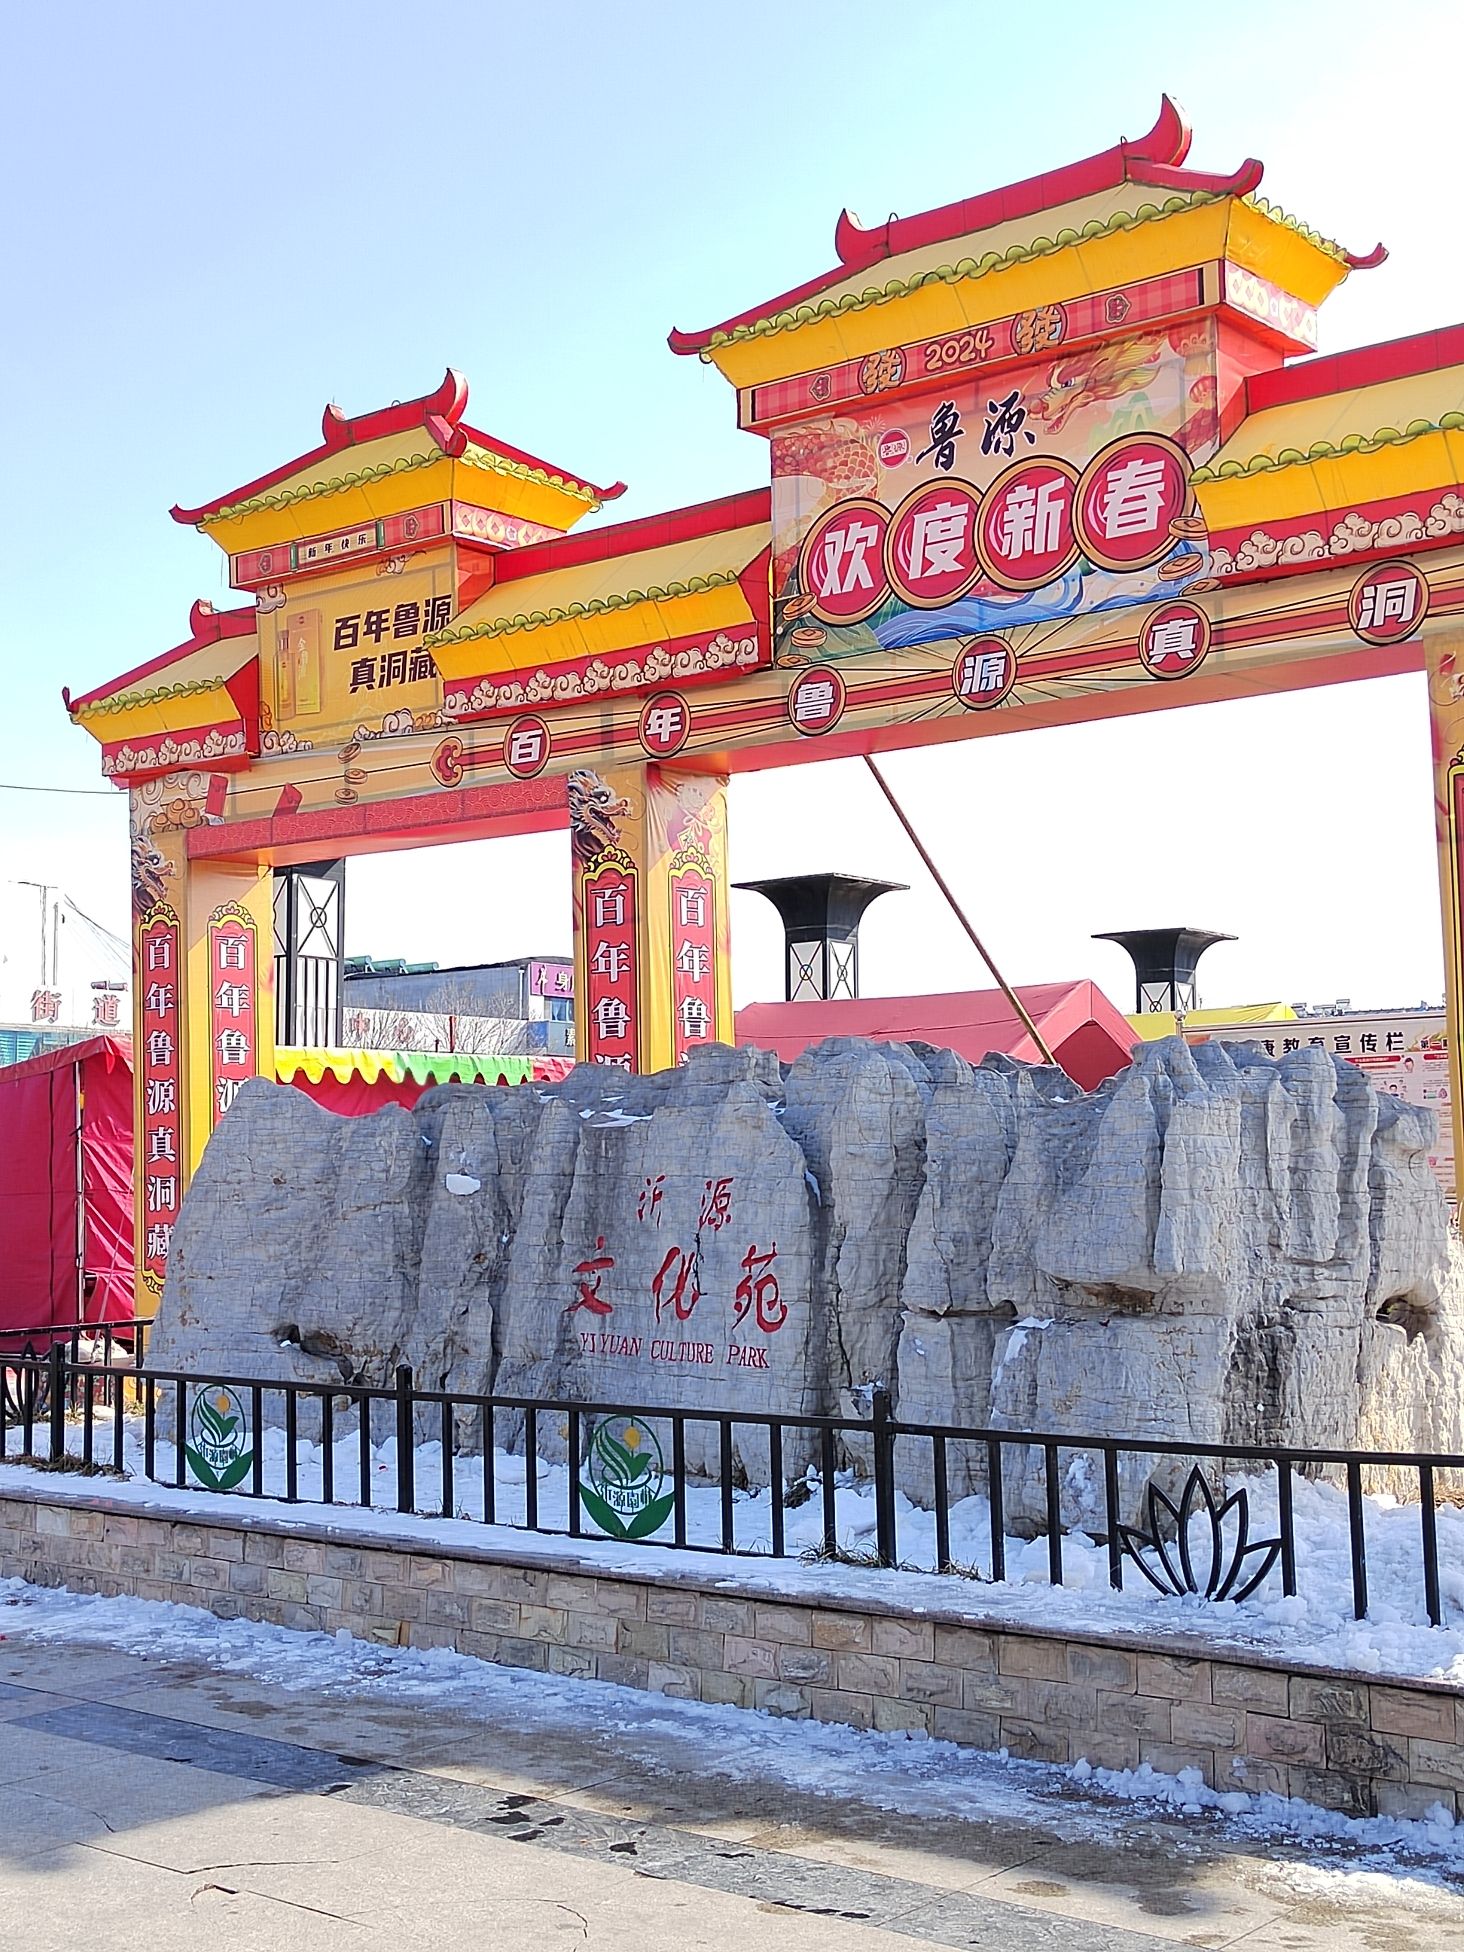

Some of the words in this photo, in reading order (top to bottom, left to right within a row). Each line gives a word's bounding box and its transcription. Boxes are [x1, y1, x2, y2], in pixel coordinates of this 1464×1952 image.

[926, 330, 994, 372] 2024
[915, 391, 1035, 473] 鲁源
[308, 533, 367, 559] 新年快乐
[819, 457, 1165, 598] 欢度新春
[333, 594, 452, 651] 百年鲁源
[349, 646, 437, 694] 真洞藏
[675, 885, 712, 1066] 百年鲁
[30, 989, 121, 1027] 街道
[145, 933, 176, 1260] 百年鲁源真洞藏
[637, 1174, 734, 1231] 沂源
[562, 1235, 788, 1333] 文化苑
[650, 1339, 714, 1364] CULTURE
[726, 1344, 770, 1370] PARK
